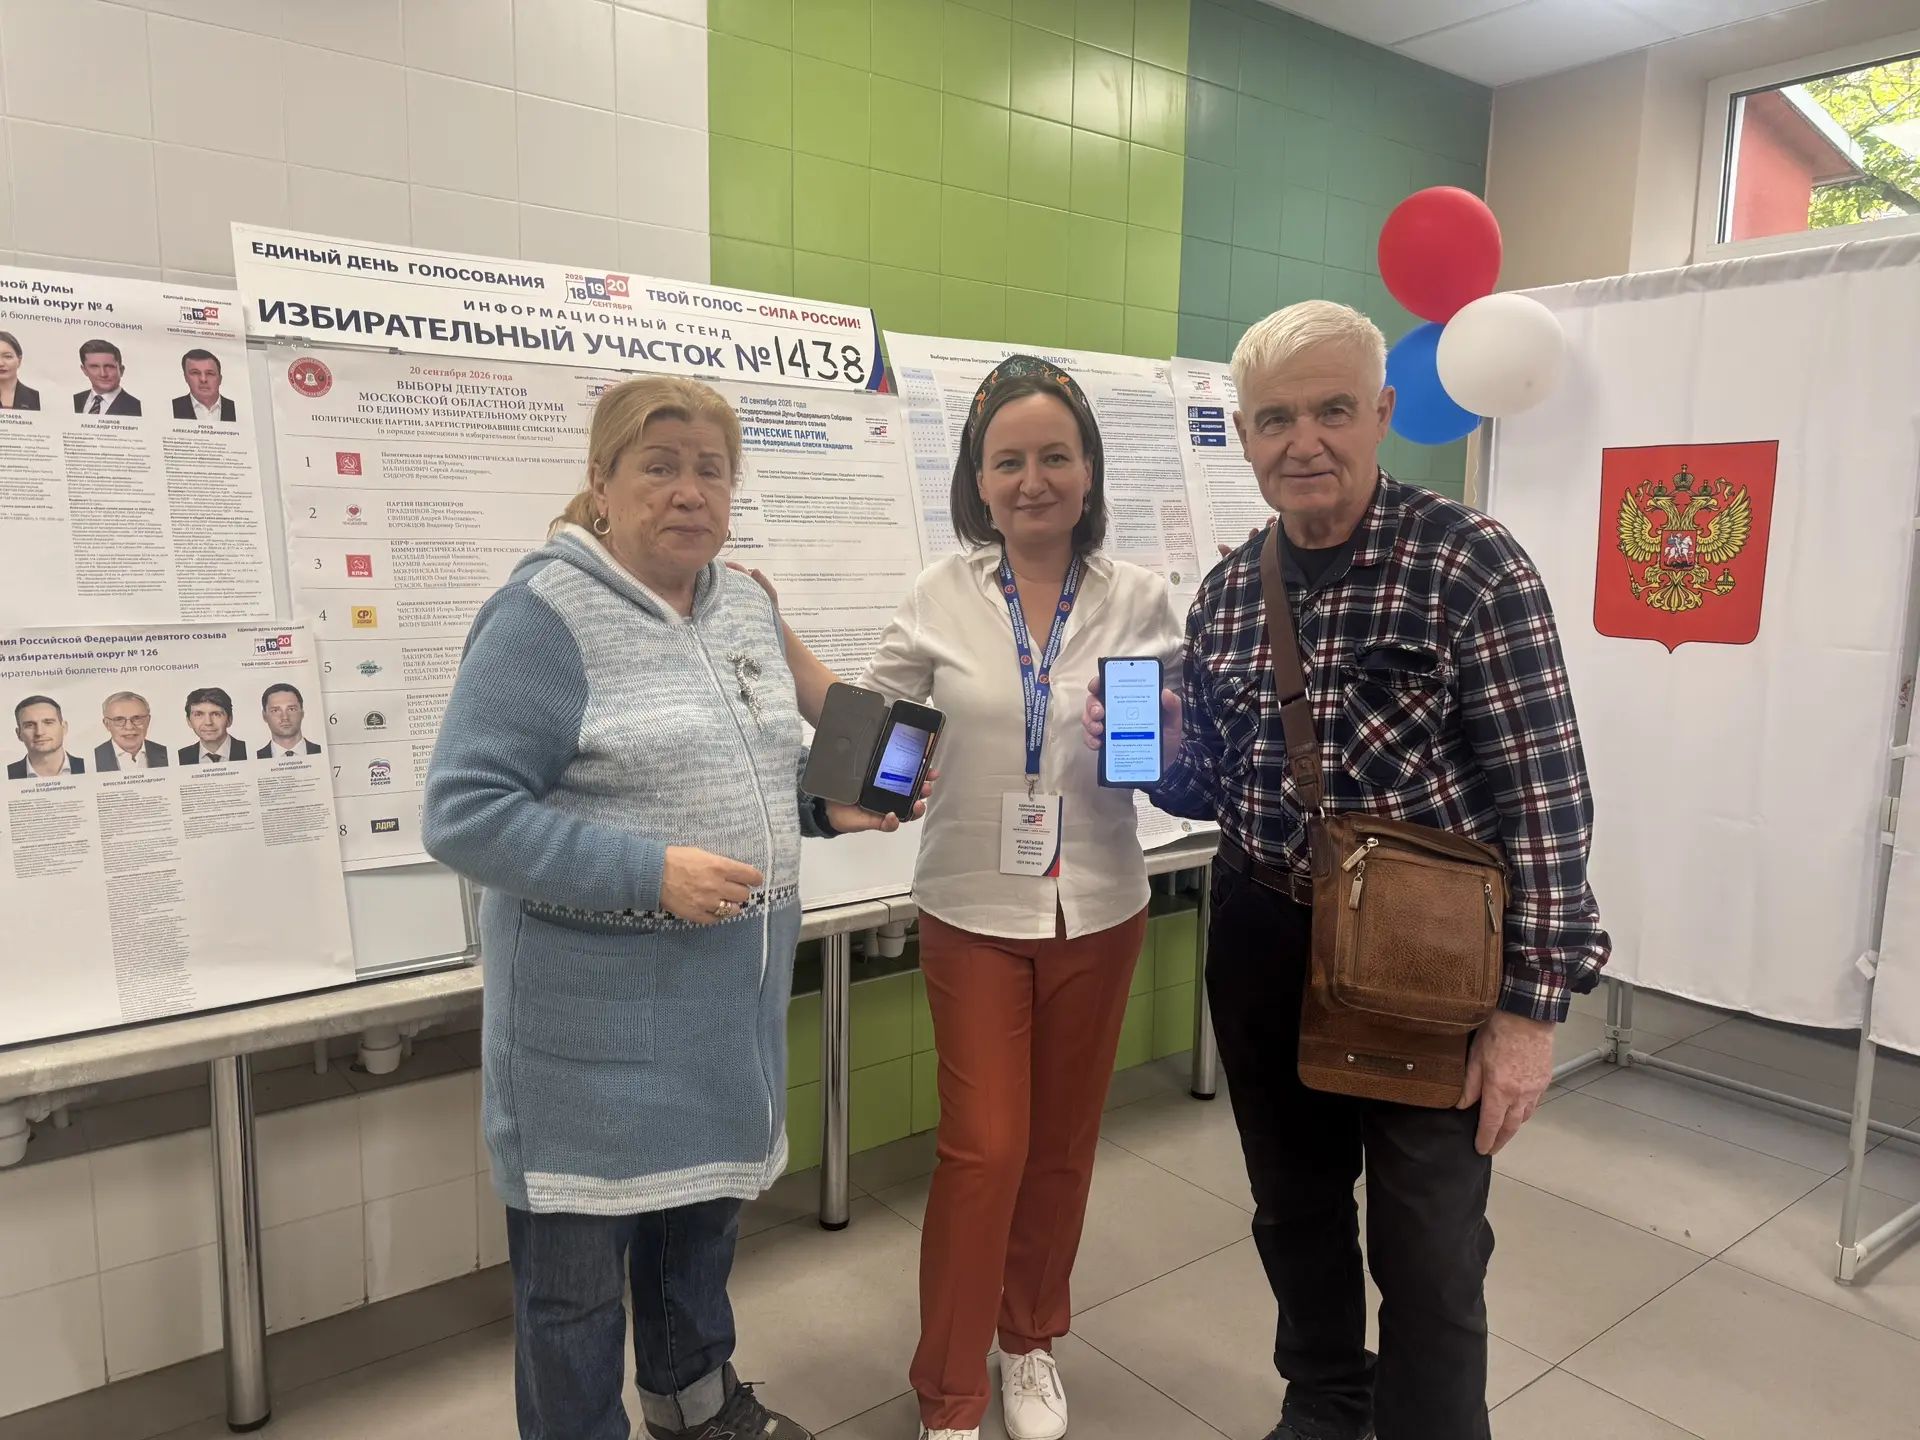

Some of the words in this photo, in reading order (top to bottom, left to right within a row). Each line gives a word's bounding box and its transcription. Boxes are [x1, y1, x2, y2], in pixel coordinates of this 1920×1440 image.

[251, 241, 342, 266] ЕДИНЫЙ
[346, 255, 399, 273] ДЕНЬ
[408, 262, 545, 289] ГОЛОСОВАНИЯ
[32, 281, 74, 294] Думы
[570, 287, 586, 299] 18
[588, 283, 604, 295] 19
[606, 279, 627, 292] 20
[43, 299, 84, 311] округ
[88, 302, 102, 311] №
[105, 303, 114, 312] 4
[592, 301, 632, 310] СЕНТЯБРЯ
[646, 288, 689, 305] ТВОЙ
[693, 295, 743, 313] ГОЛОС
[758, 305, 798, 322] СИЛА
[801, 311, 861, 329] РОССИИ!
[9, 311, 62, 324] бюллетень
[64, 317, 81, 325] для
[83, 319, 143, 331] голосования
[463, 299, 667, 331] ИНФОРМАЦИОННЫЙ
[676, 322, 732, 341] СТЕНД
[258, 298, 575, 352] ИЗБИРАТЕЛЬНЫЙ
[583, 332, 726, 369] УЧАСТОК
[409, 366, 420, 375] 20
[423, 367, 467, 378] сентября
[469, 370, 491, 379] 2026
[492, 372, 513, 381] года
[397, 380, 452, 393] ВЫБОРЫ
[456, 383, 528, 397] ДЕПУТАТОВ
[359, 391, 448, 405] МОСКОВСКОЙ
[451, 397, 526, 410] ОБЛАСТНОЙ
[528, 401, 564, 411] ДУМЫ
[740, 396, 748, 404] 20
[749, 397, 777, 407] сентября
[793, 401, 807, 409] года
[358, 404, 374, 413] ПО
[376, 405, 430, 416] ЕДИНОМУ
[432, 408, 527, 421] ИЗБИРАТЕЛЬНОМУ
[530, 414, 567, 423] ОКРУГУ
[311, 414, 383, 425] ПОЛИТИЧЕСКИЕ
[425, 419, 521, 432] ЗАРЕГИСТРИРОВАВШИЕ
[522, 425, 555, 433] СПИСКИ
[304, 456, 311, 467] 1
[308, 507, 317, 519] 2
[314, 558, 322, 570] 3
[319, 609, 327, 621] 4
[19, 636, 82, 645] Российской
[84, 634, 143, 644] Федерации
[145, 633, 190, 642] девятого
[192, 632, 227, 640] созыва
[267, 641, 277, 649] 19
[279, 637, 290, 645] 20
[8, 650, 94, 662] избирательный
[96, 651, 125, 659] округ
[127, 649, 138, 657] №
[140, 648, 158, 656] 126
[65, 666, 118, 675] бюллетень
[120, 666, 137, 674] для
[139, 663, 199, 672] голосования
[323, 662, 332, 673] 5
[329, 713, 338, 725] 6
[333, 765, 342, 777] 7
[339, 824, 348, 836] 8
[375, 821, 395, 830] ЛДПР
